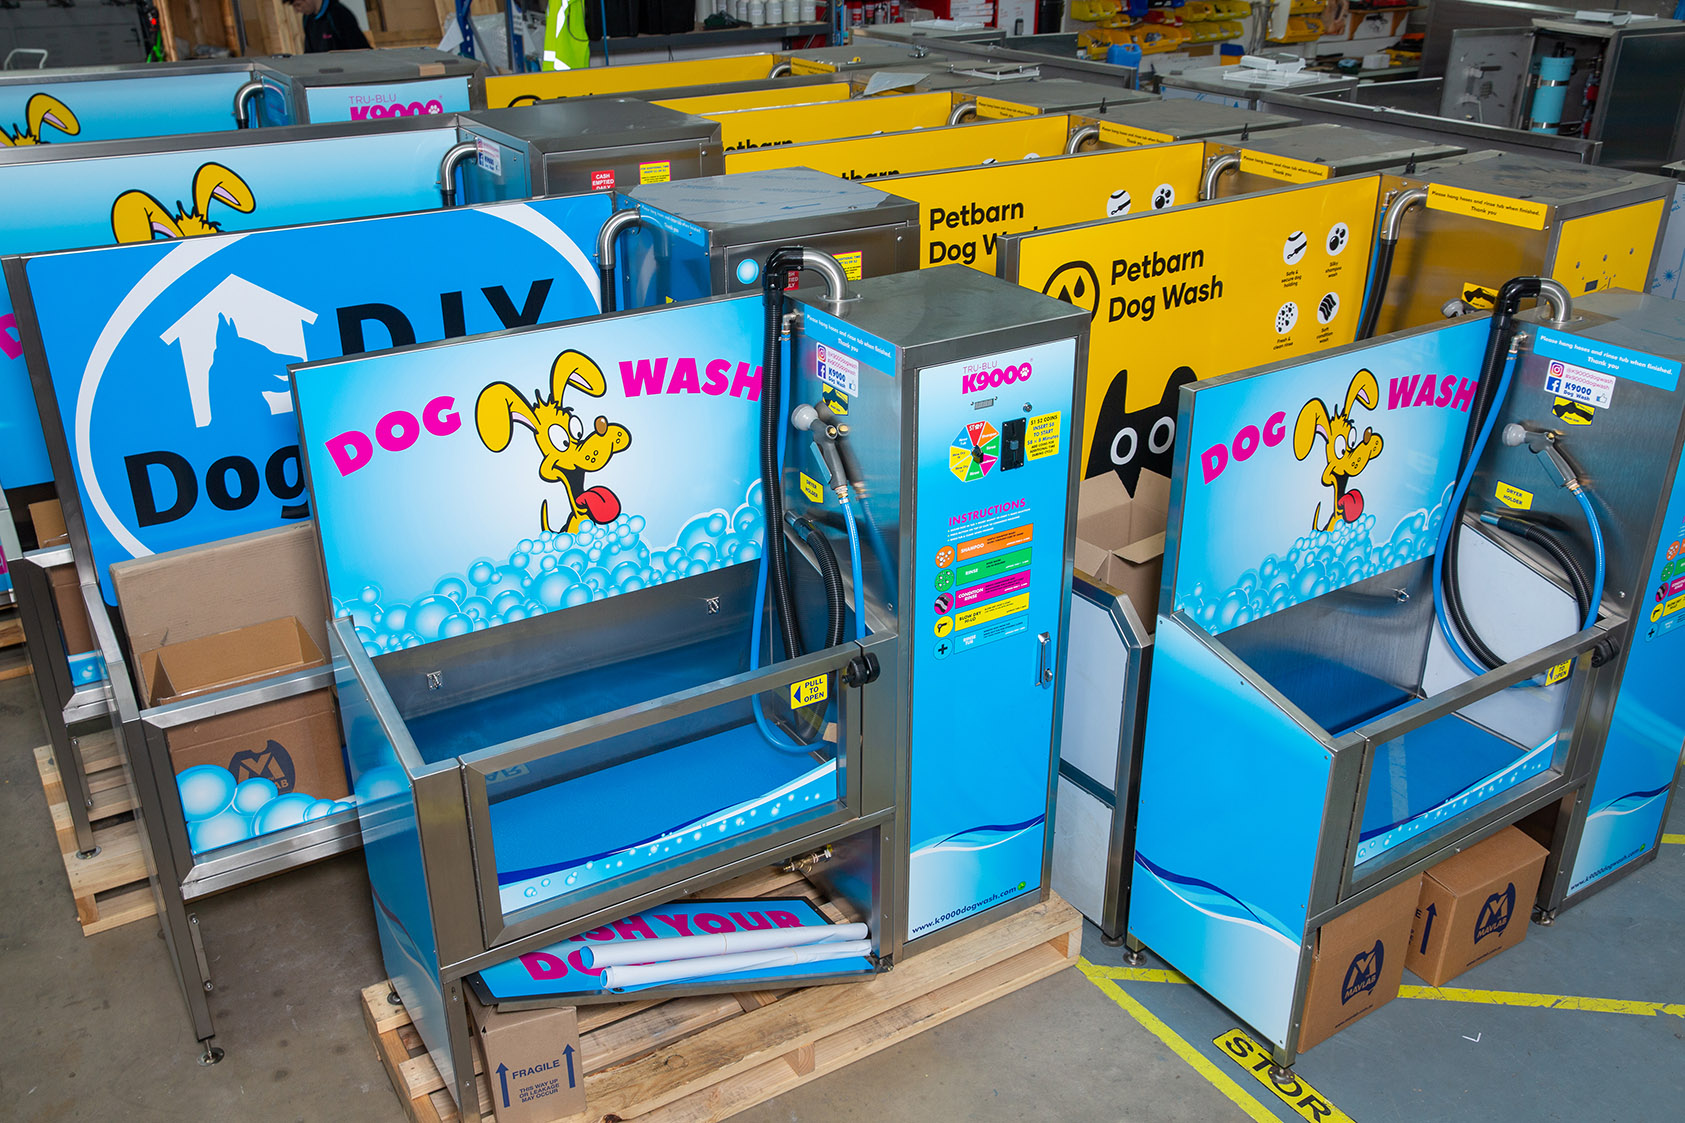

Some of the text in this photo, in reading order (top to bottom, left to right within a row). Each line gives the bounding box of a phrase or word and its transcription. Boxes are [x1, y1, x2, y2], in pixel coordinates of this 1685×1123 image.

[348, 94, 396, 104] TRU-BLU
[929, 200, 1024, 231] Petbarn
[929, 240, 976, 264] Dog
[1111, 248, 1204, 286] Petbarn
[1108, 275, 1223, 322] Dog Wash
[1540, 336, 1557, 345] Please
[1559, 338, 1573, 349] hang
[1574, 342, 1590, 353] hoses
[1591, 347, 1602, 356] and
[1603, 350, 1618, 361] rinse
[1619, 354, 1629, 363] tub
[1630, 358, 1646, 369] when
[963, 360, 997, 374] TRU-BLU
[1588, 356, 1619, 370] Thank you
[828, 367, 846, 382] K9000
[962, 362, 1032, 394] K9000
[1565, 382, 1592, 395] K9000
[1576, 393, 1590, 401] Wash
[325, 357, 763, 477] DOG WASH
[1200, 374, 1478, 485] DOG WASH
[124, 444, 310, 528] Dog
[1506, 488, 1522, 497] DRYER
[1503, 495, 1522, 504] HOLDER
[949, 498, 1026, 526] INSTRUCTIONS
[960, 543, 985, 554] SHAMPOO
[959, 613, 972, 621] BLOW
[804, 678, 823, 688] PULL
[810, 686, 819, 694] TO
[804, 691, 824, 703] OPEN
[912, 886, 1016, 933] www.k9000dogwash.com
[661, 910, 804, 938] YOUR
[1477, 917, 1508, 938] MAVLAB
[1344, 975, 1376, 999] MAVLAB
[512, 1059, 560, 1080] FRAGILE
[530, 1083, 560, 1096] LEAKAGE
[534, 1081, 548, 1089] WAY
[536, 1089, 558, 1099] OCCUR
